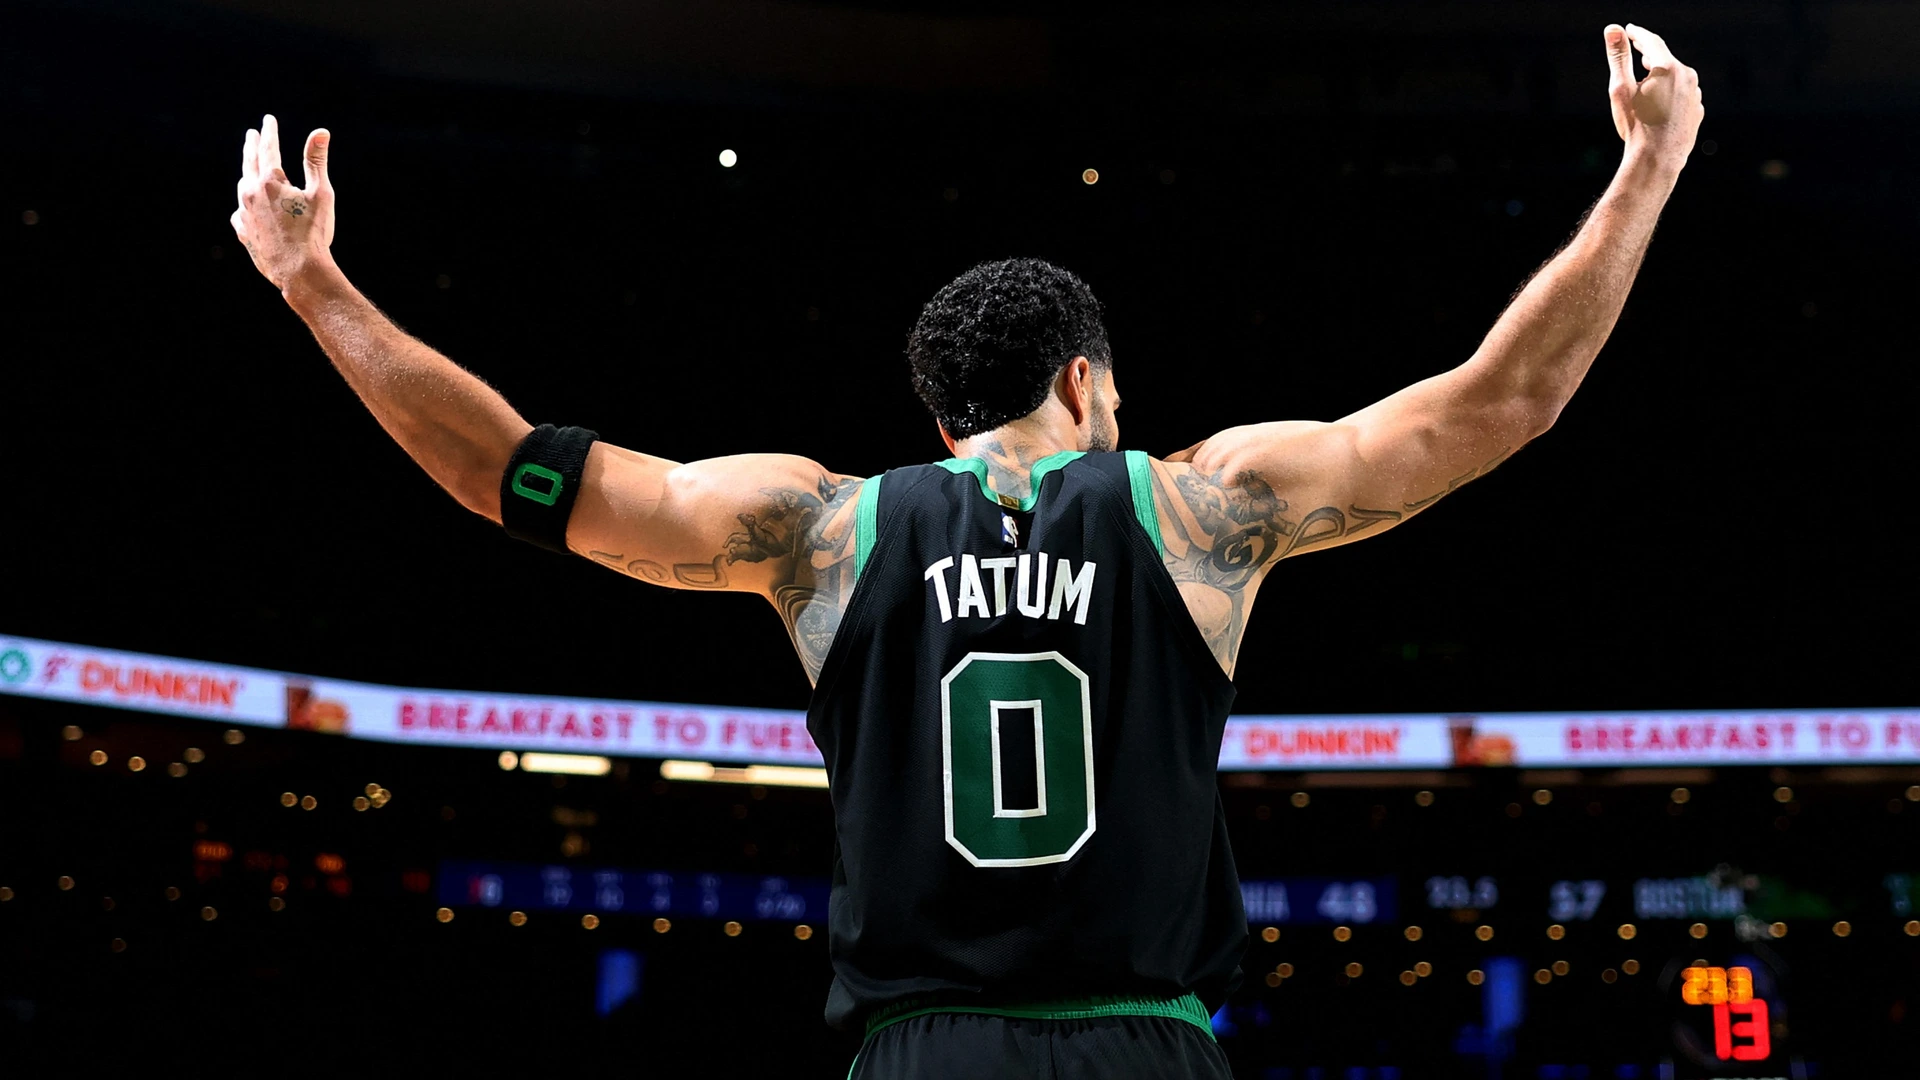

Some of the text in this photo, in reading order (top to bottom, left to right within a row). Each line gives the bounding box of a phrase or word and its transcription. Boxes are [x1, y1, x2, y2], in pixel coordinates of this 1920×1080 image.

[512, 463, 563, 506] 0
[924, 551, 1096, 625] TATUM
[400, 702, 632, 741] BREAKFAST
[654, 711, 706, 745] TO
[1568, 719, 1797, 750] BREAKFAST
[1816, 719, 1871, 751] TO
[941, 651, 1096, 868] 0
[1714, 998, 1771, 1060] 13
